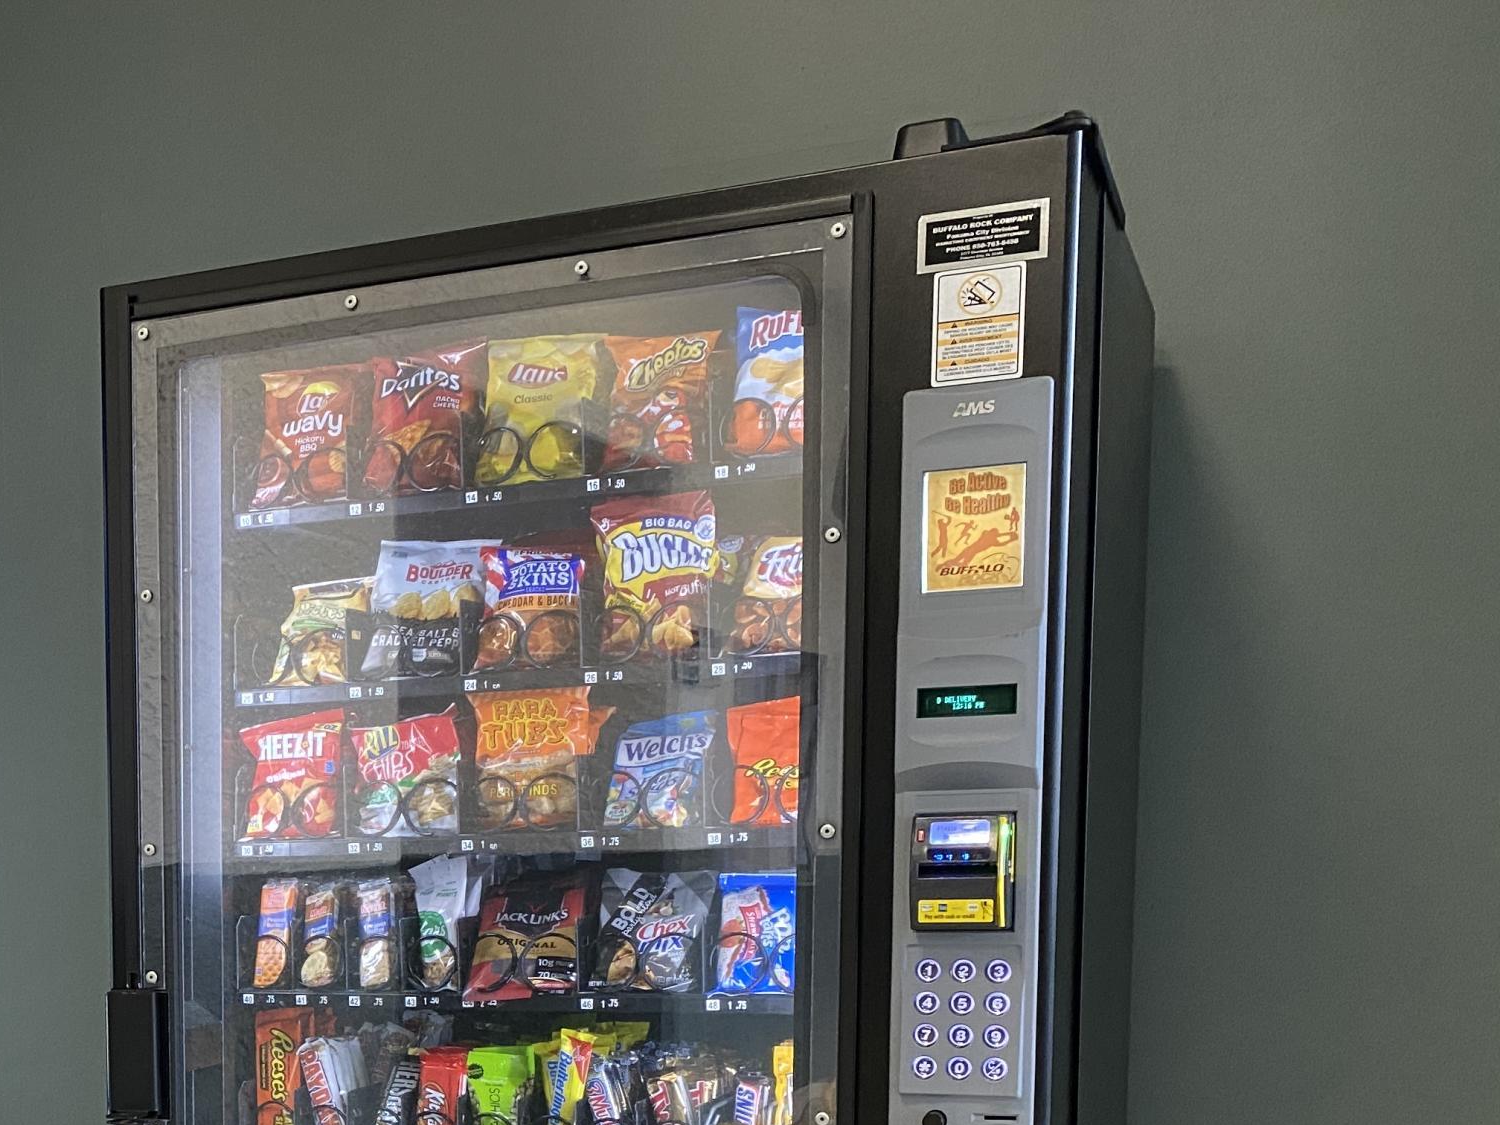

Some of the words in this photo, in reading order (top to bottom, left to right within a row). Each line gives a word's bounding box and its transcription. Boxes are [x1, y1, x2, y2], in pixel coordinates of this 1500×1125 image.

[969, 220, 992, 229] ROCK
[993, 213, 1034, 225] COMPANY
[627, 337, 708, 392] Cheetos
[381, 366, 460, 398] Doritos
[513, 393, 554, 405] Classic
[953, 399, 995, 418] AMS
[588, 480, 599, 491] 16
[966, 471, 1008, 492] Active
[645, 517, 666, 527] BIG
[667, 518, 692, 530] BAG
[406, 562, 474, 583] BOULDER
[510, 561, 570, 577] POTATO
[939, 563, 1004, 577] BUFFALO
[507, 572, 570, 590] SKINS
[390, 625, 413, 637] SEA
[418, 627, 447, 638] SALT
[713, 664, 725, 675] 28
[585, 672, 597, 683] 26
[464, 679, 476, 690] 24
[493, 699, 558, 721] PAPA
[624, 734, 708, 762] Welch's
[462, 840, 473, 850] 34
[581, 836, 594, 847] 36
[611, 887, 650, 931] BOLD
[495, 911, 528, 923] JACK
[636, 914, 695, 942] Chex
[924, 965, 933, 976] 1
[958, 965, 969, 977] 2
[994, 965, 1005, 977] 3
[581, 999, 593, 1009] 46
[707, 1000, 719, 1011] 48
[921, 997, 933, 1009] 4
[957, 997, 968, 1009] 5
[992, 998, 1003, 1009] 6
[921, 1029, 931, 1040] 7
[955, 1030, 966, 1041] 8
[991, 1030, 1001, 1042] 9
[269, 1027, 295, 1102] Reese's
[954, 1062, 965, 1073] 0
